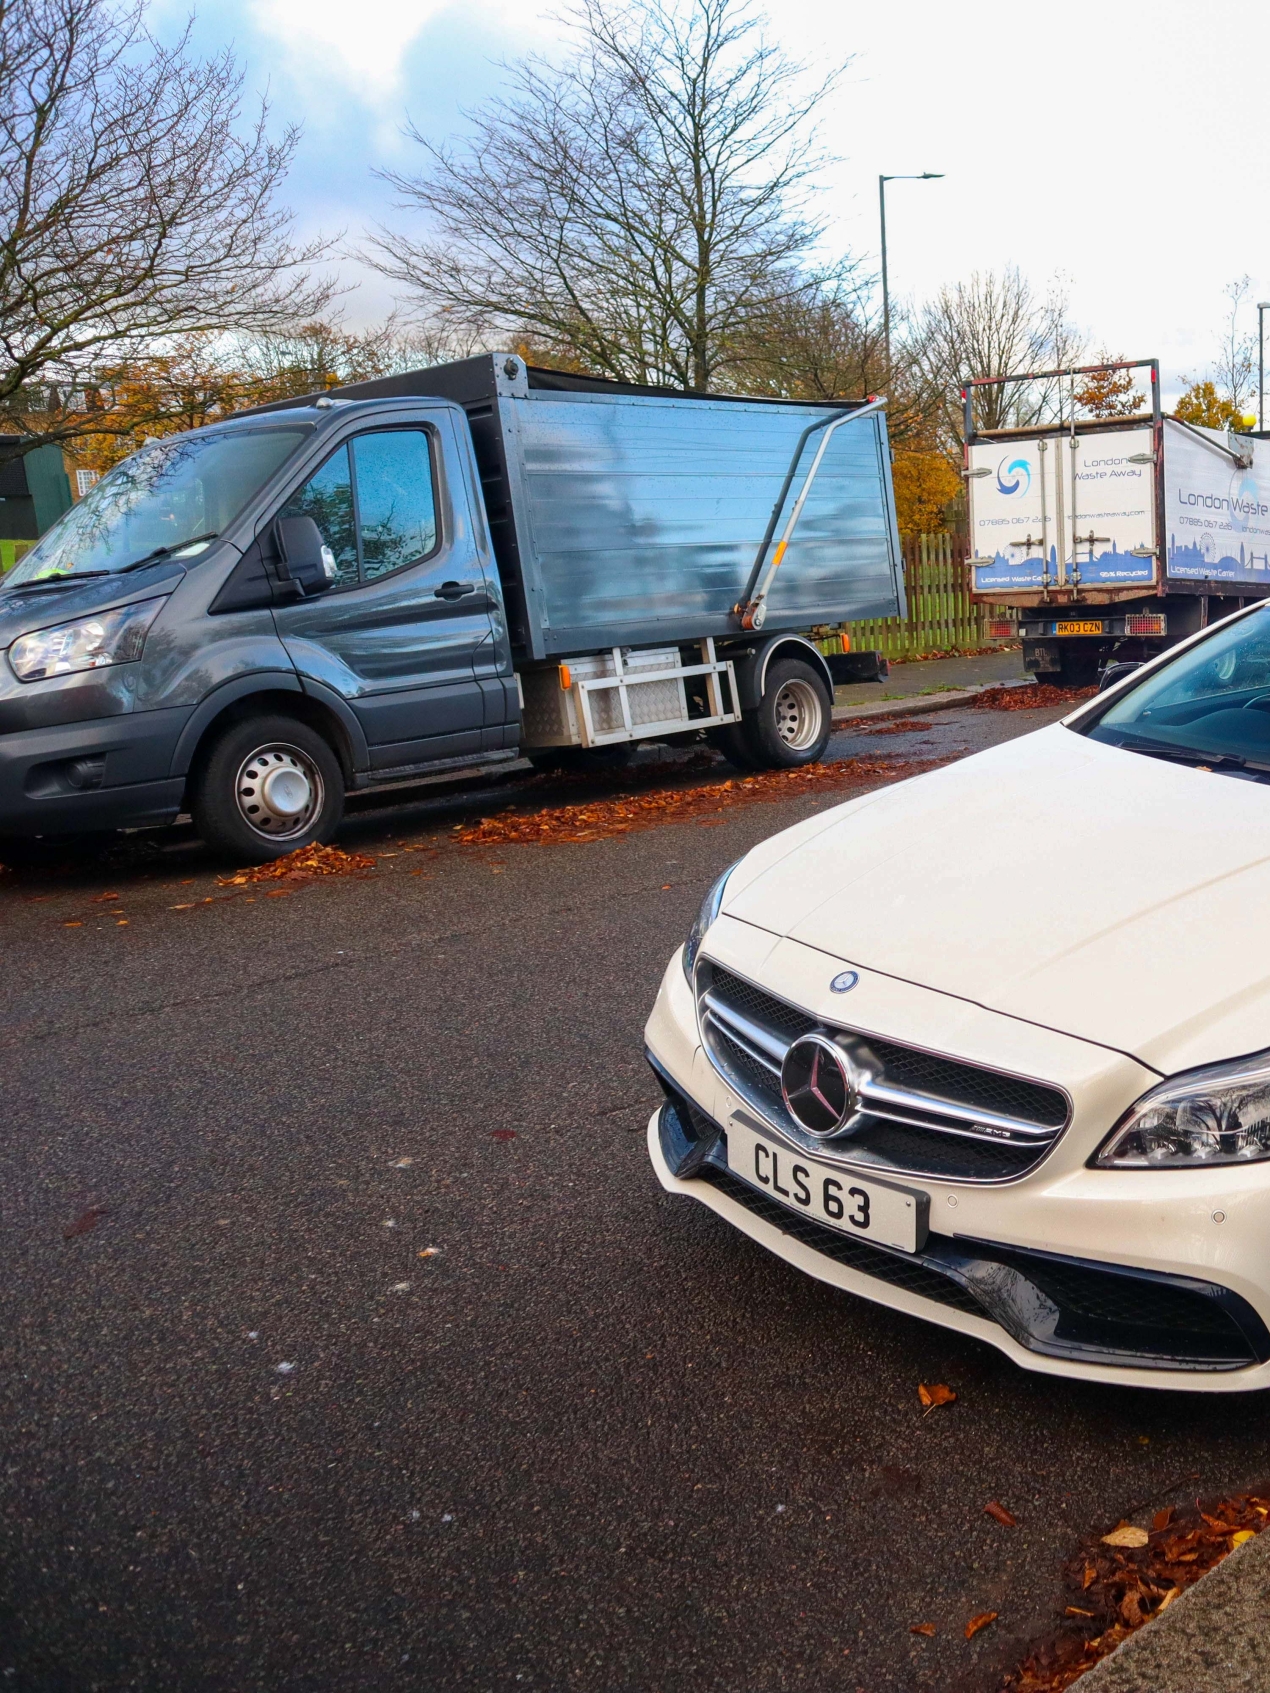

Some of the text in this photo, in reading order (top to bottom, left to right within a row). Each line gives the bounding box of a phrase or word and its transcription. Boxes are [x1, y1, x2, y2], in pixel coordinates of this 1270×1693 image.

[1083, 457, 1128, 468] London
[1074, 469, 1142, 480] Waste Away
[1178, 488, 1230, 511] London
[1231, 497, 1269, 516] Waste
[1011, 517, 1030, 525] 067
[1204, 519, 1218, 529] 067
[1116, 569, 1149, 578] Recycled
[1170, 565, 1236, 578] Licensed Waste Carrier
[1058, 622, 1101, 633] RK03 CZN
[754, 1142, 811, 1207] CLS
[823, 1177, 870, 1230] 63
